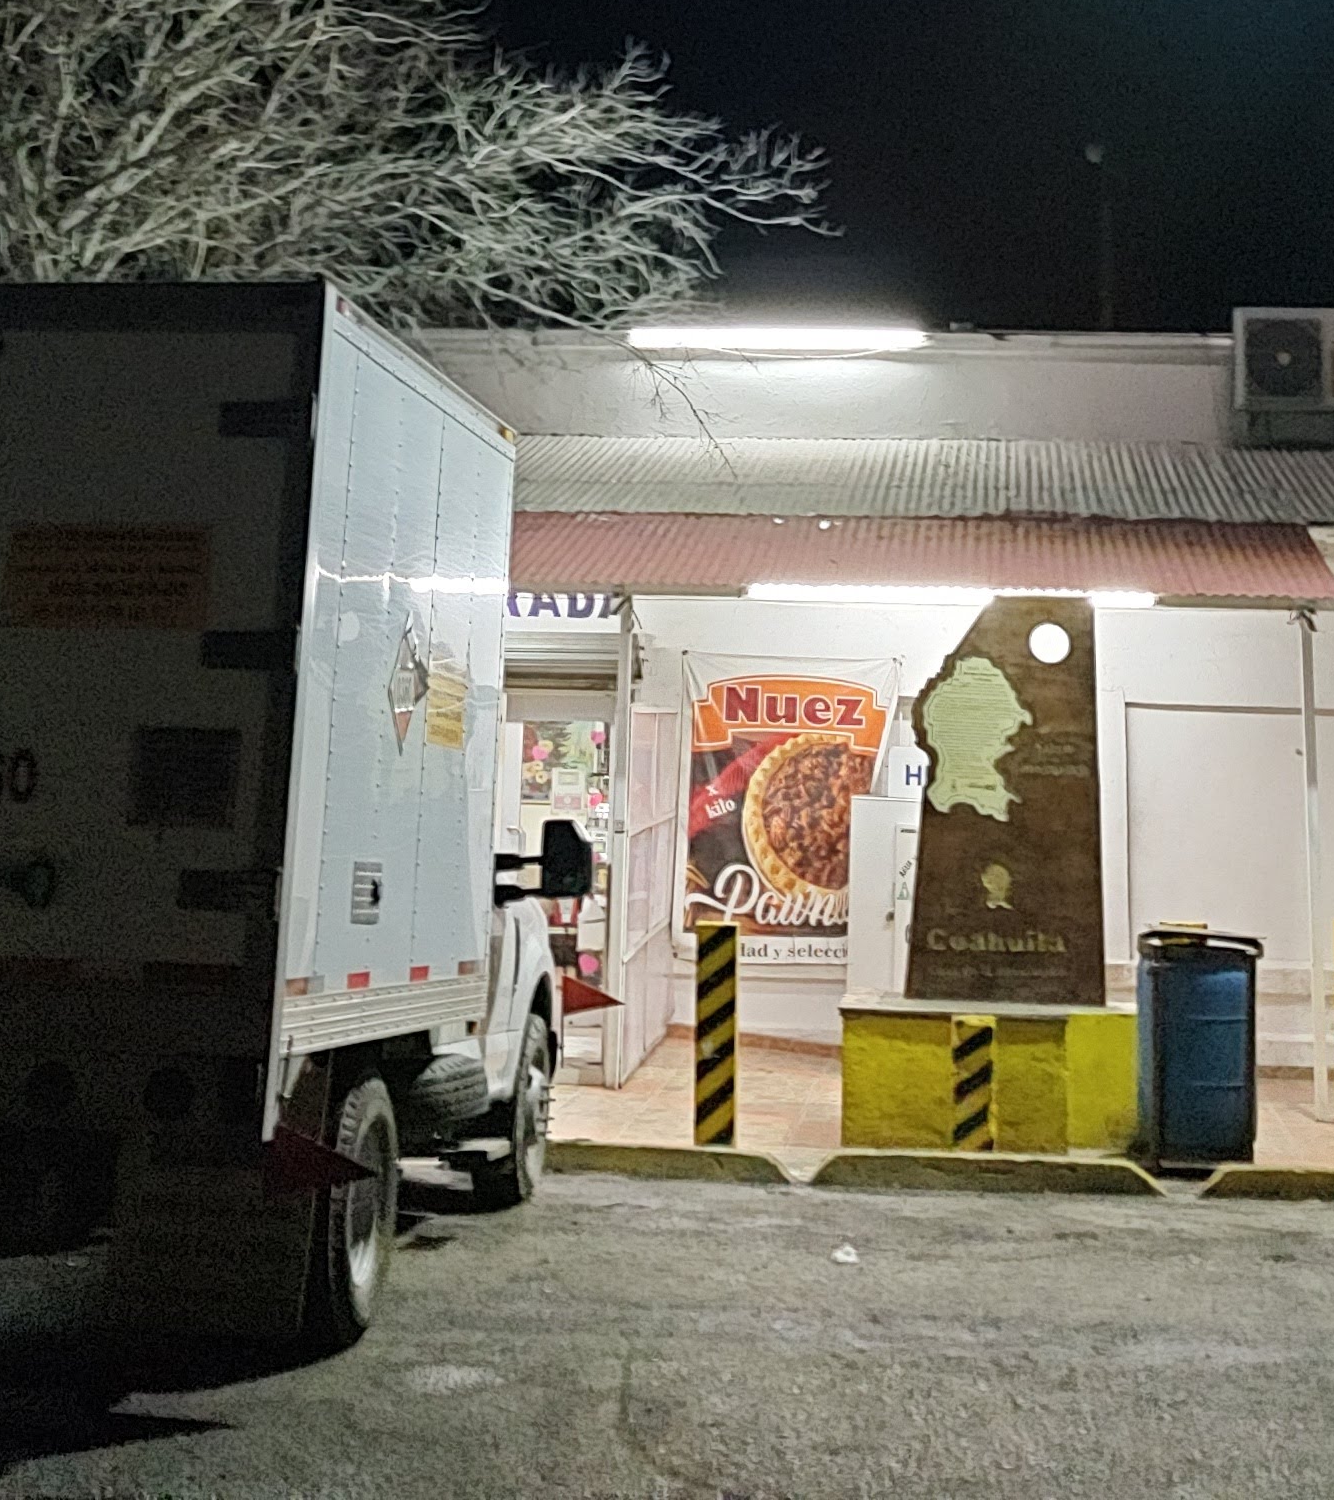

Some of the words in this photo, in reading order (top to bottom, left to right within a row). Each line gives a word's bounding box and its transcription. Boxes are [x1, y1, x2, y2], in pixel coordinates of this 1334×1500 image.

[723, 685, 865, 727] Nuez
[705, 798, 736, 820] kilo
[926, 928, 1067, 953] Coahuila
[773, 948, 783, 960] y
